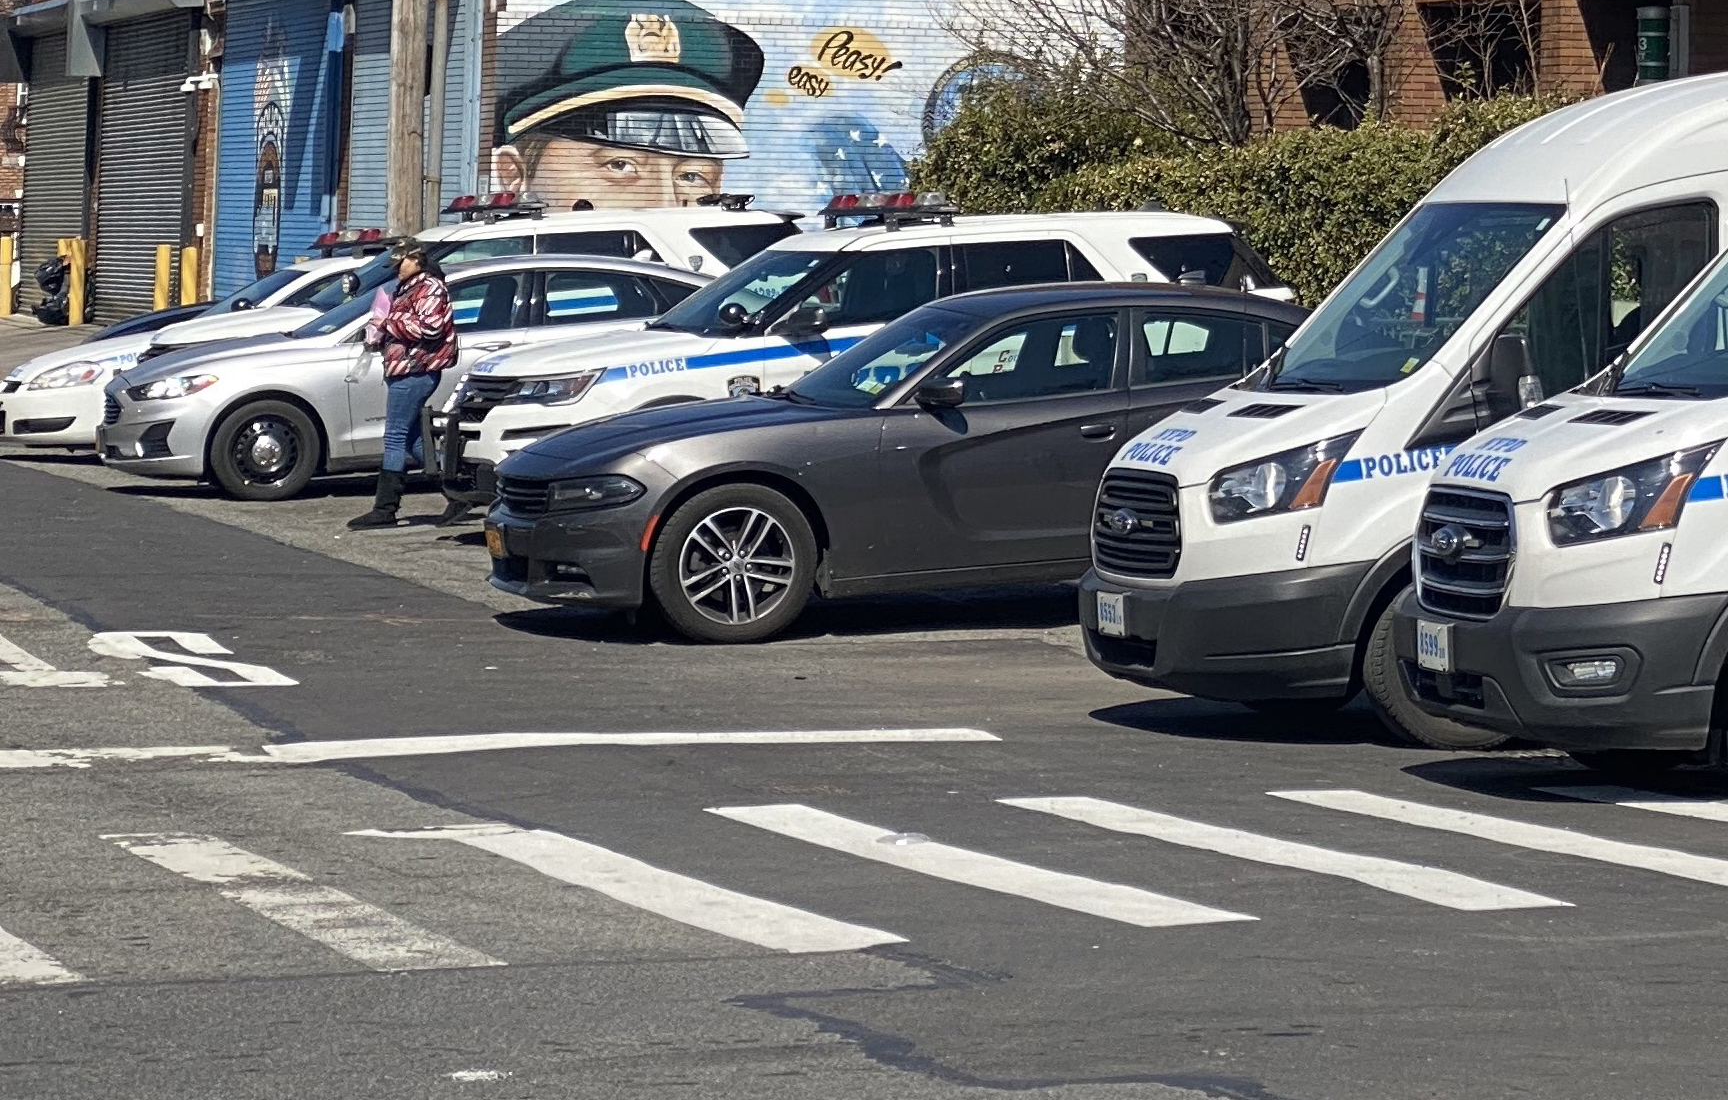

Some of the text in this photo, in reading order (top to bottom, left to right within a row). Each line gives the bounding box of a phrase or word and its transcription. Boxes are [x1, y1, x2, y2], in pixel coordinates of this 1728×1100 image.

[817, 30, 903, 81] Peasy!
[788, 66, 829, 98] easy
[628, 358, 685, 378] POLICE
[1151, 428, 1198, 442] NYPD
[1476, 437, 1529, 453] NYPD
[1120, 442, 1184, 466] POLICE
[1443, 453, 1513, 482] POLICE
